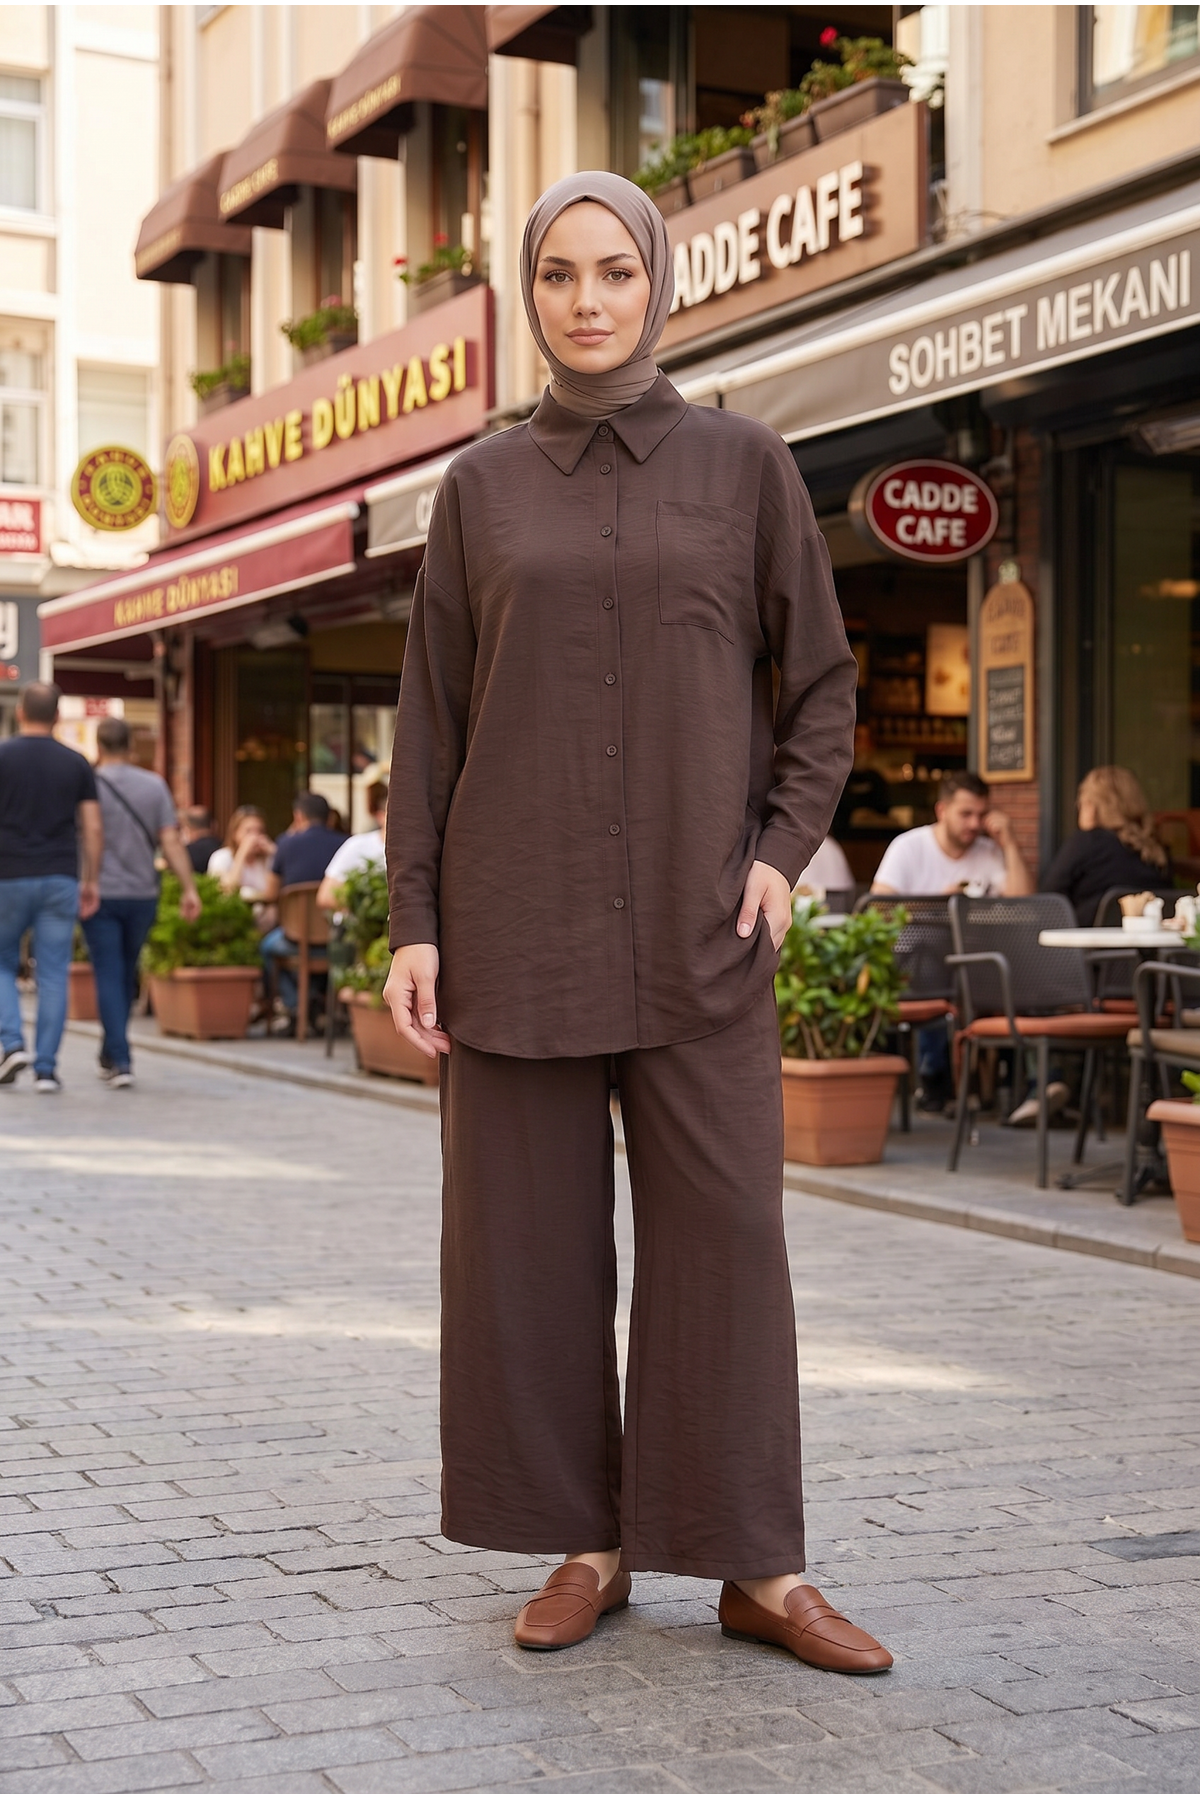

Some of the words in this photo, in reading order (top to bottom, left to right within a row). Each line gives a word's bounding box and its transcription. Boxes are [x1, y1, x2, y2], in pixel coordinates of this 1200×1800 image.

[669, 206, 762, 314] ADDE
[766, 160, 864, 270] CAFE
[888, 303, 1028, 396] SOHBET
[1036, 249, 1191, 352] MEKANI
[208, 408, 303, 493] KAHVE
[311, 335, 467, 450] DÜNYASI
[883, 478, 979, 515] CADDE
[895, 514, 967, 548] CAFE
